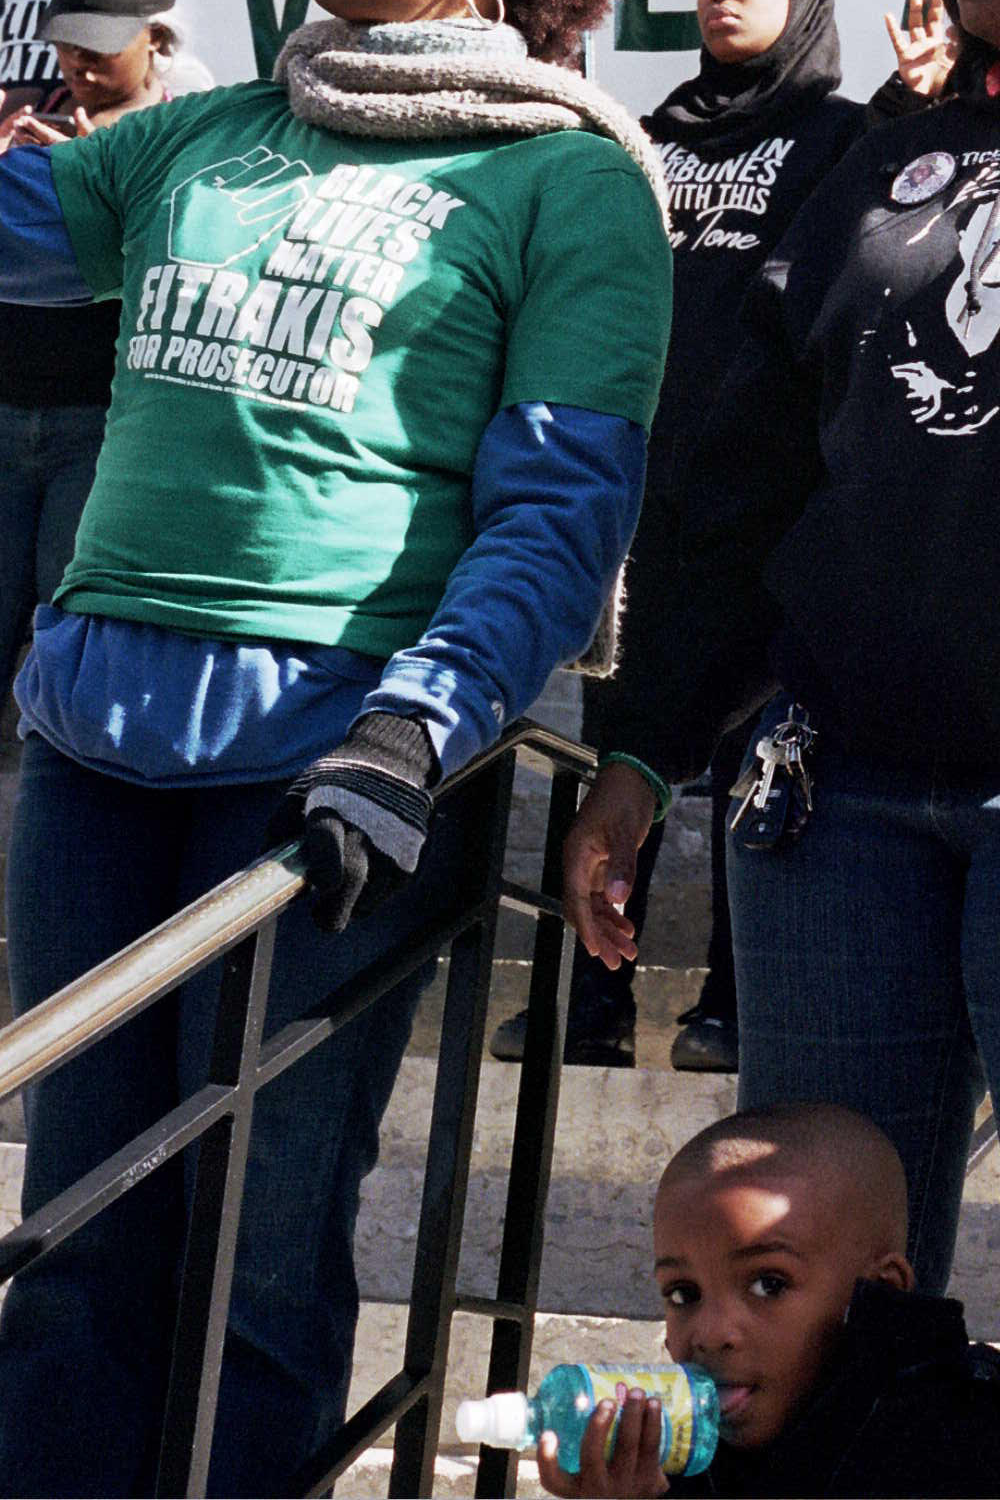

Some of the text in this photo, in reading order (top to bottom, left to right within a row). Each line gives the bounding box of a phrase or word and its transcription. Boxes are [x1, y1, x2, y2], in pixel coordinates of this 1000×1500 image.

[316, 164, 466, 230] BLACK
[717, 183, 771, 215] THIS
[285, 198, 432, 263] LIVES
[265, 240, 405, 303] MATTER
[136, 264, 384, 373] FITRAKIS
[127, 334, 163, 370] FOR
[161, 336, 360, 413] PROSECUTOR
